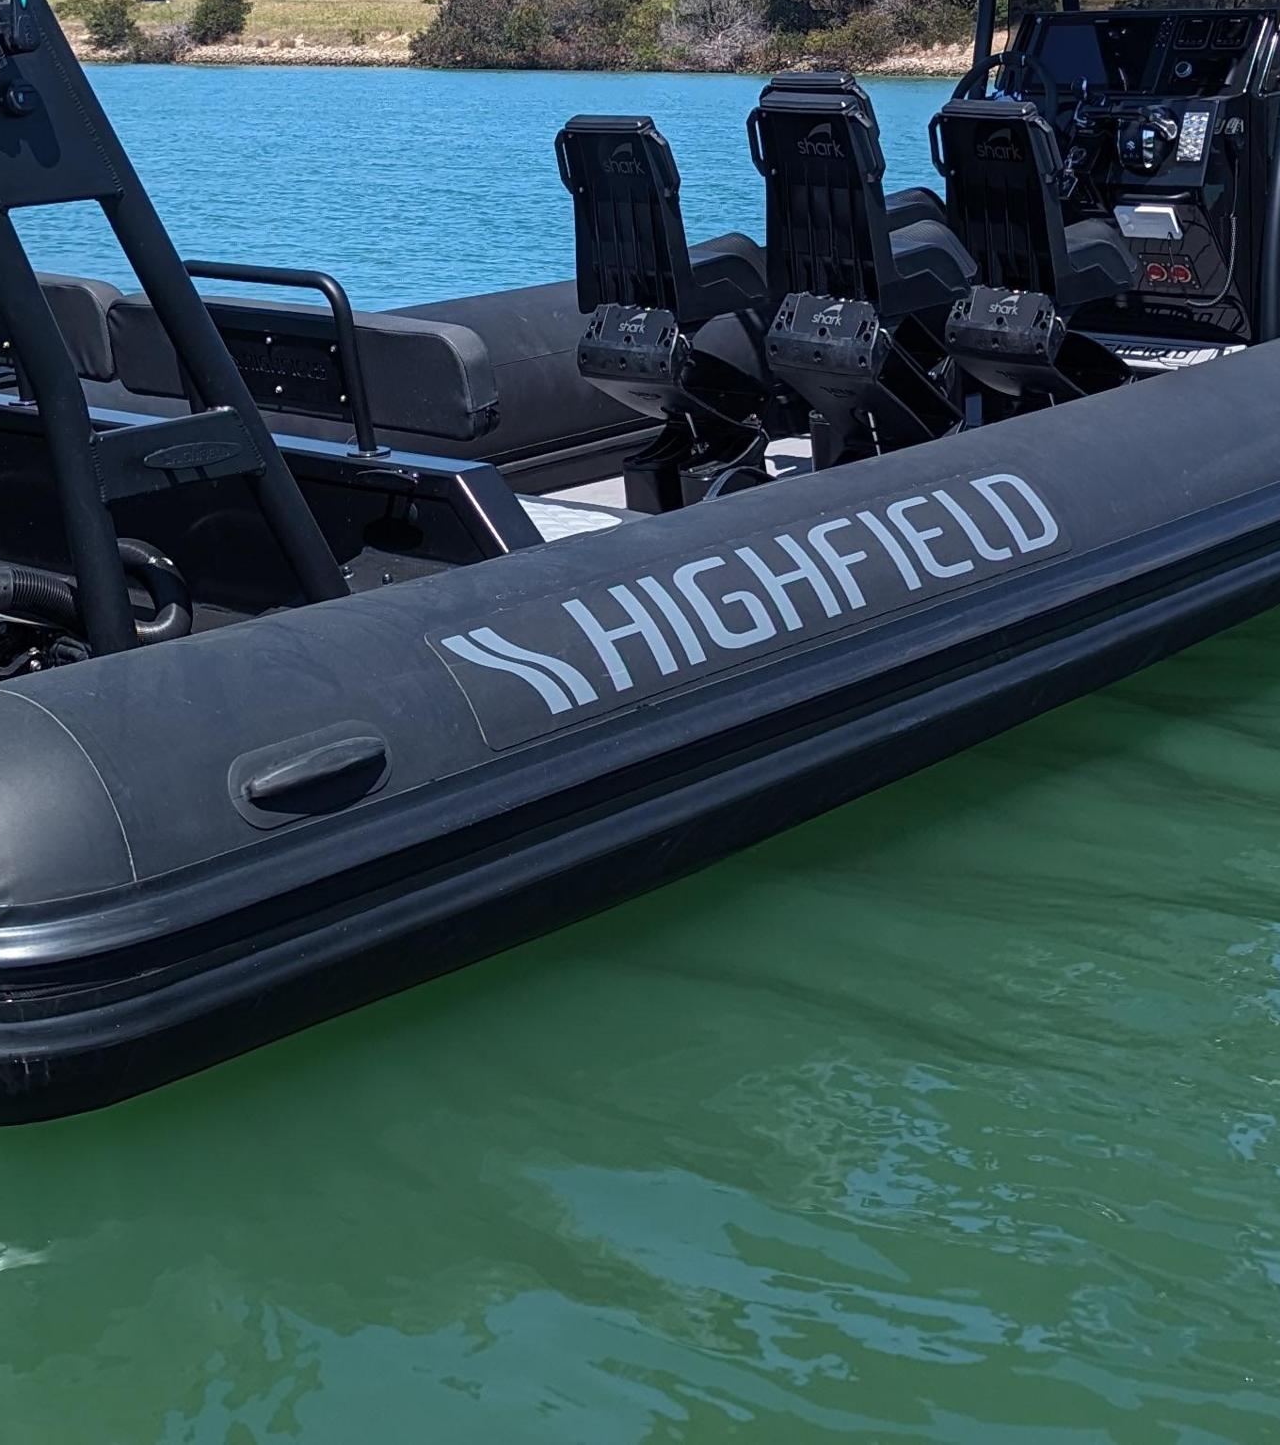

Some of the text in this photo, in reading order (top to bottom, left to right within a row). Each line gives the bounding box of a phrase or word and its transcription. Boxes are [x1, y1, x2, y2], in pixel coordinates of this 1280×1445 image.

[797, 137, 845, 158] shark
[976, 142, 1023, 161] shark
[603, 157, 645, 174] shark
[989, 302, 1018, 315] shark
[618, 321, 645, 334] shark
[811, 312, 842, 326] shark
[561, 473, 1060, 693] HIGHFIELD
